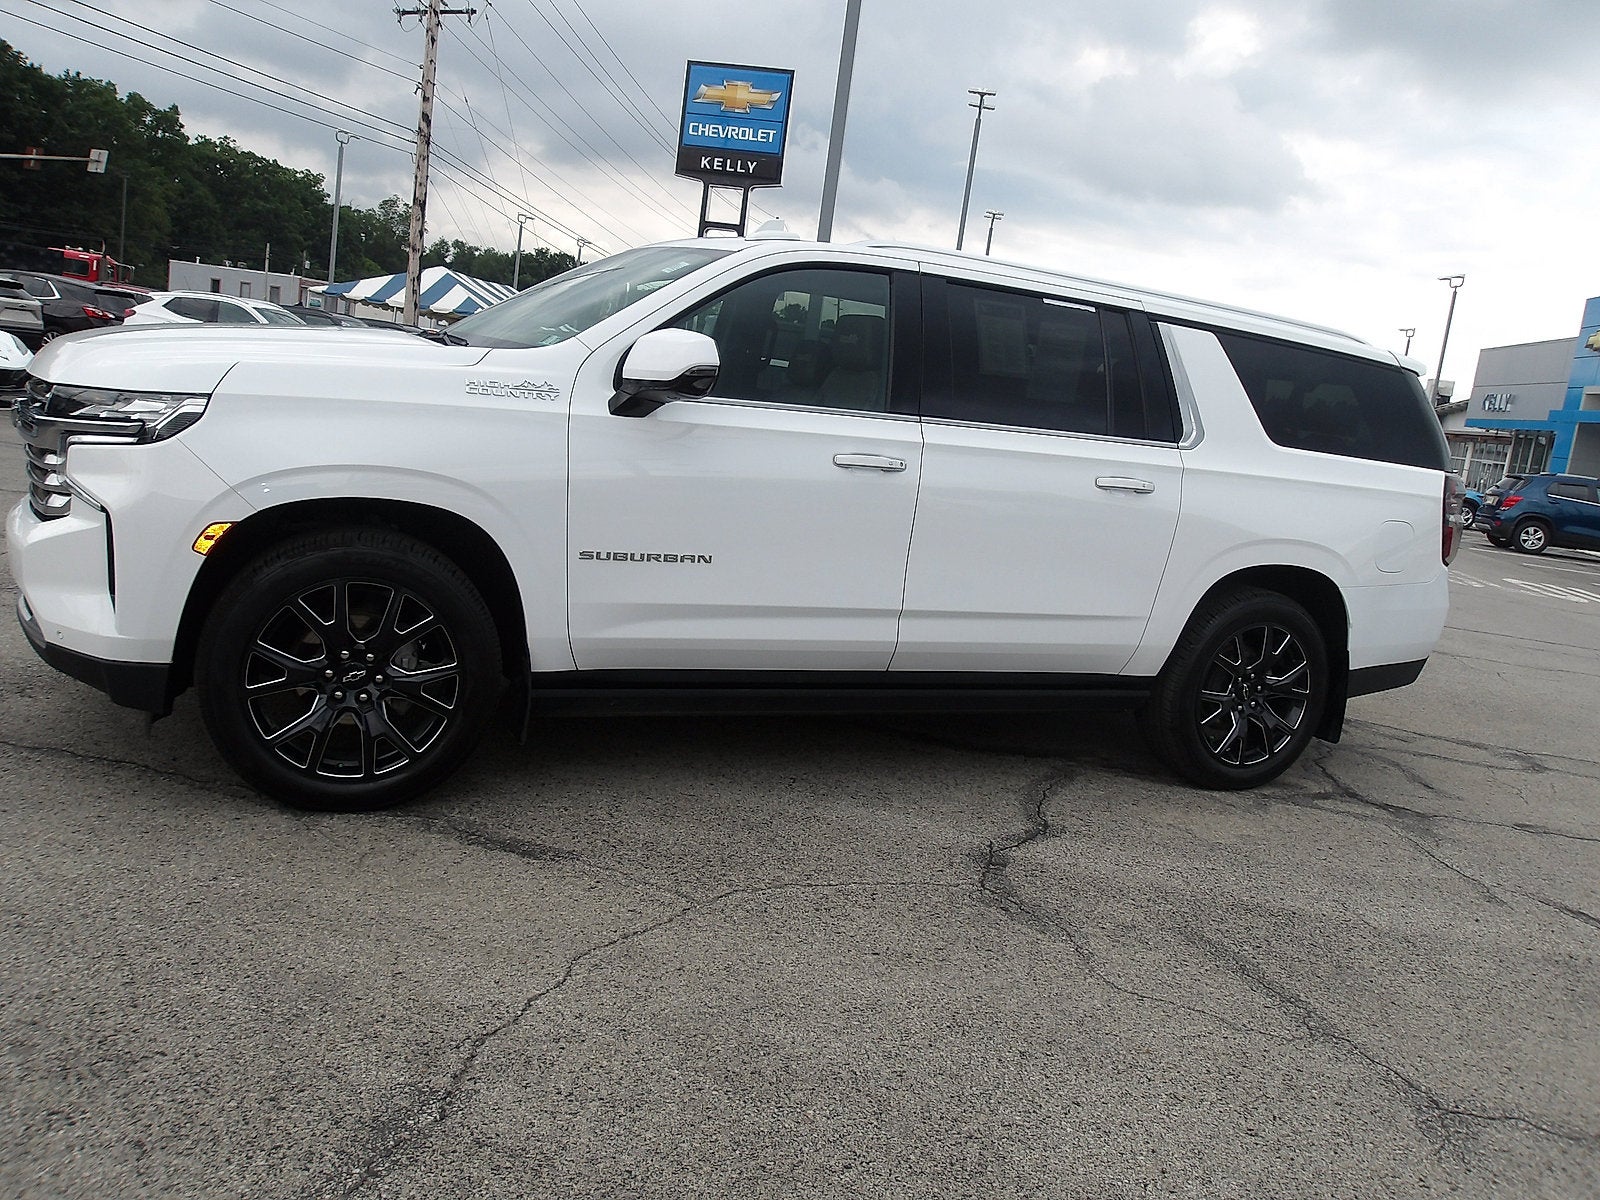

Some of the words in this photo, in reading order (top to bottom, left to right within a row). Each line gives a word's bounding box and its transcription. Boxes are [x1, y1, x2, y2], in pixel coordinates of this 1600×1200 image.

[688, 122, 777, 143] CHEVROLET
[700, 156, 758, 174] KELLY
[465, 379, 511, 389] HIGH
[465, 385, 560, 401] COUNTRY
[578, 550, 713, 564] SUBURBAN
